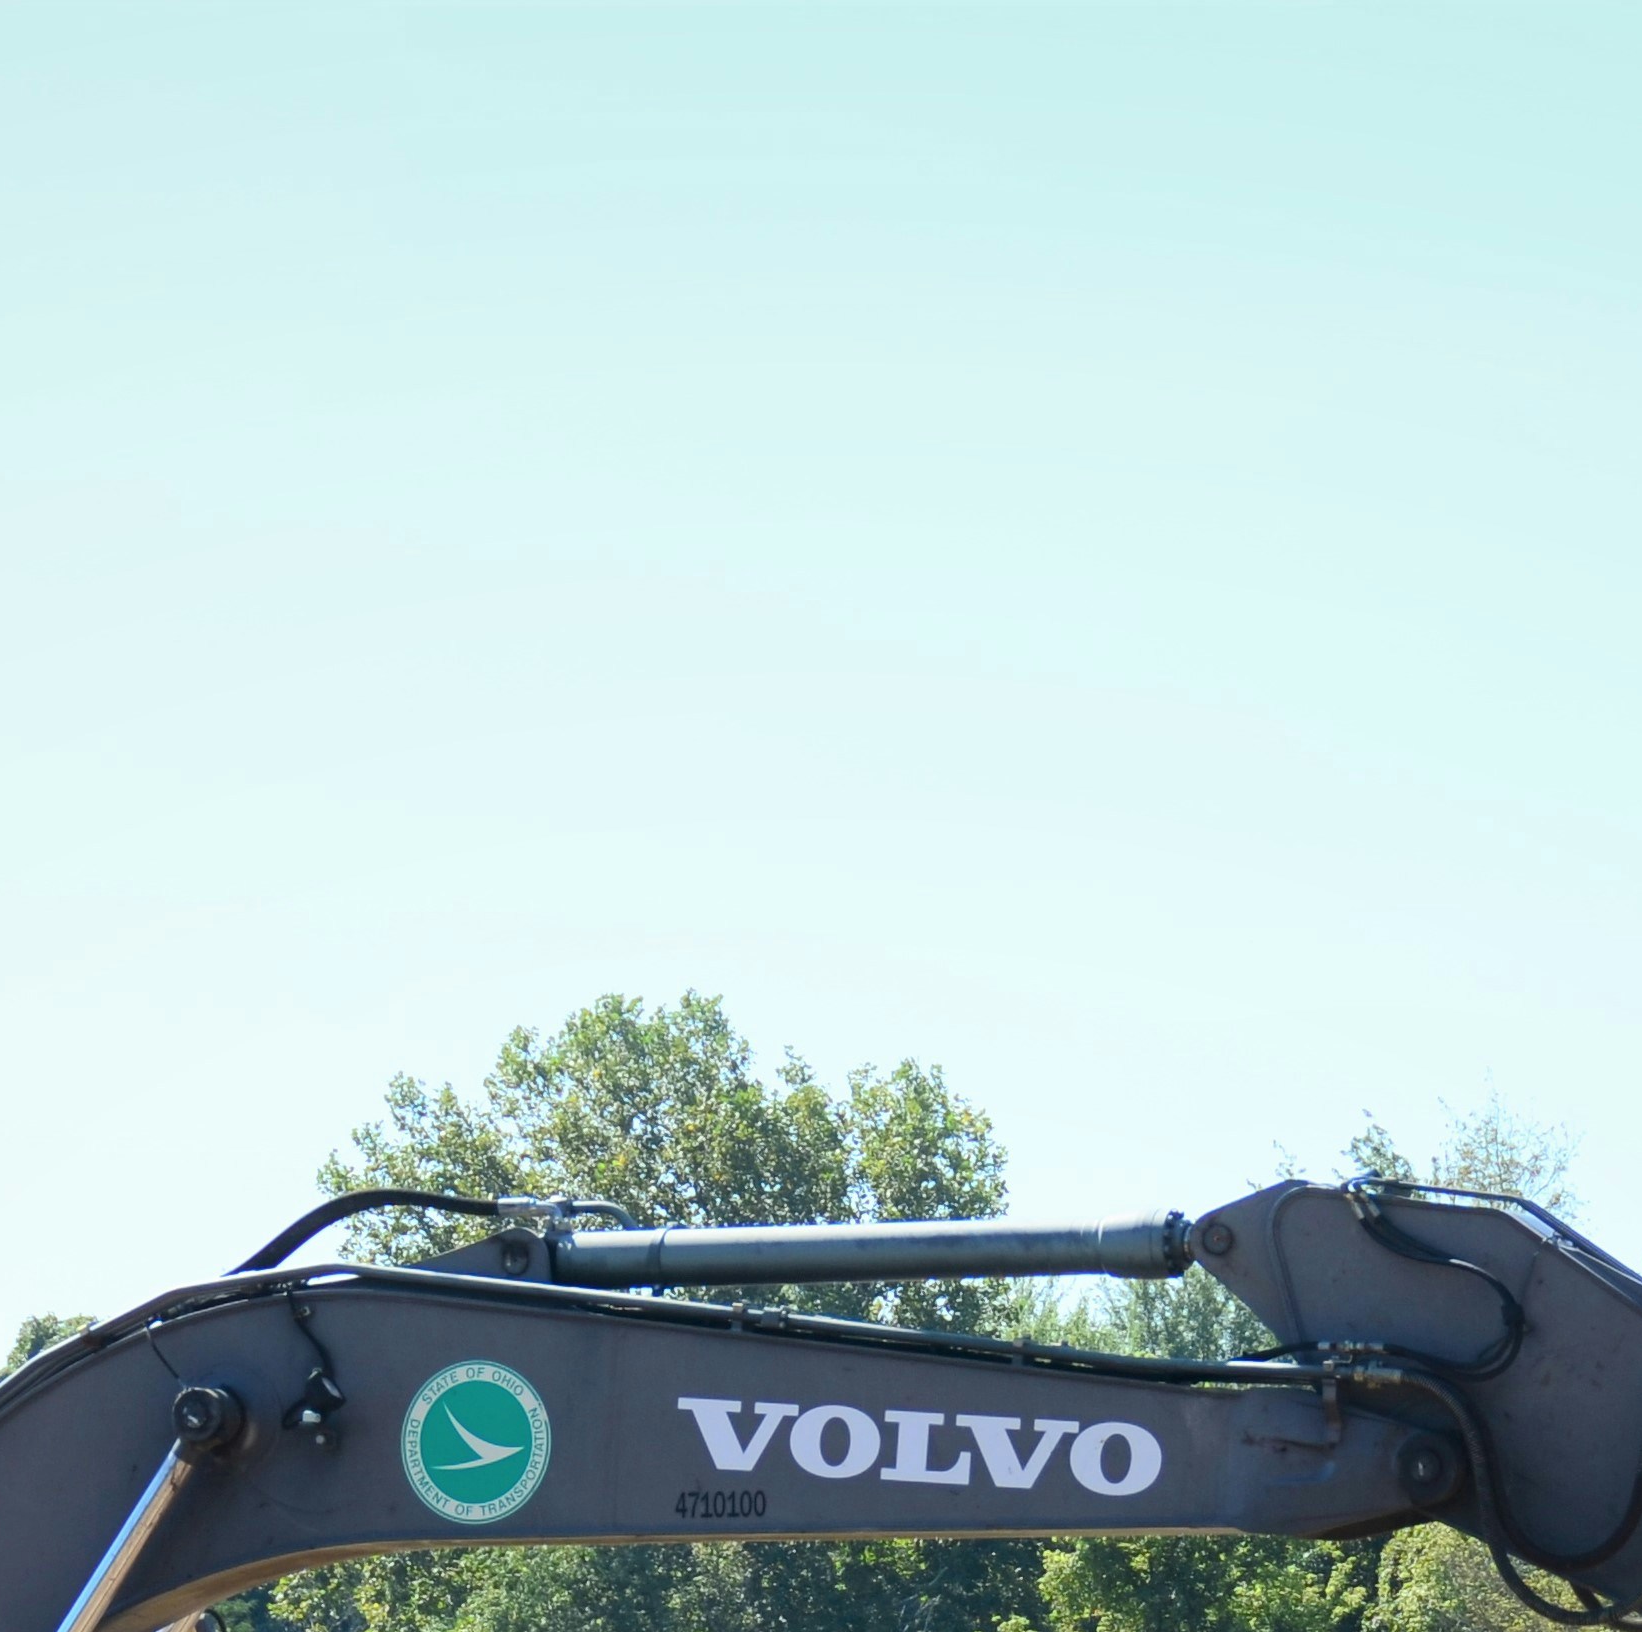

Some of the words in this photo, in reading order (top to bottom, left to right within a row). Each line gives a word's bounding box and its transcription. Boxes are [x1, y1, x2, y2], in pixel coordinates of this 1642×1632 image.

[422, 1370, 459, 1405] STATE
[465, 1367, 485, 1379] OF
[491, 1370, 524, 1397] OHIO
[407, 1418, 450, 1509] DEPARTMENT
[454, 1503, 474, 1516] OF
[479, 1407, 545, 1517] TRANSPORTATION
[677, 1397, 1162, 1496] VOLVO
[675, 1490, 767, 1519] 4710100
